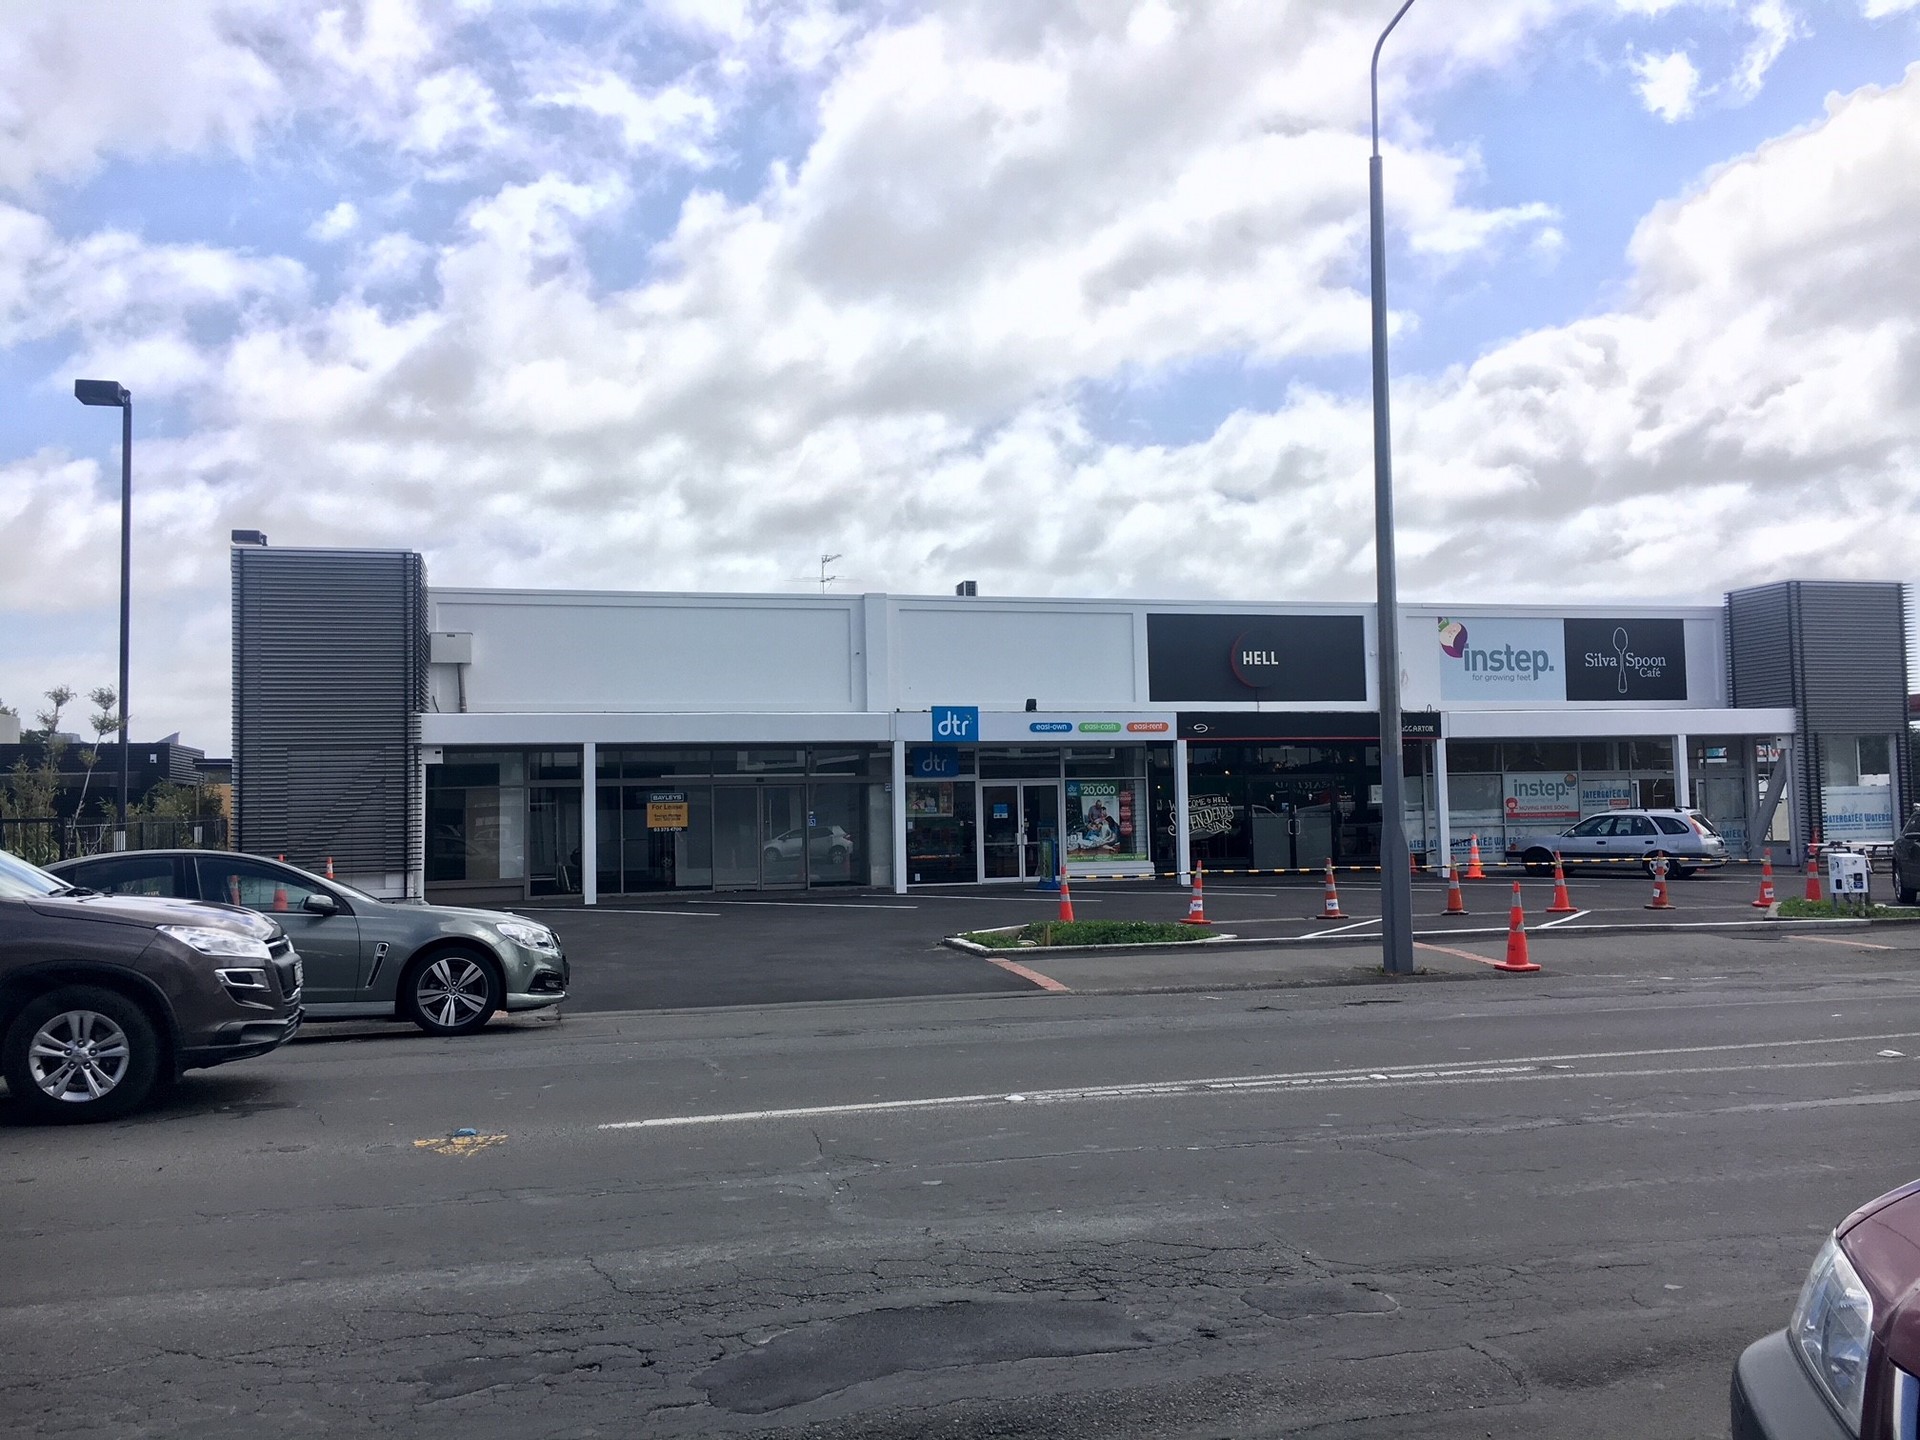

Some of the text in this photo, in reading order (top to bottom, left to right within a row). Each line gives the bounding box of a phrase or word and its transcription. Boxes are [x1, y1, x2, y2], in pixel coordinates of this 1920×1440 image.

[1242, 651, 1278, 664] HELL
[1464, 643, 1554, 680] instep.
[1584, 652, 1666, 669] Silva Spoon
[1485, 674, 1515, 682] growing
[1640, 667, 1661, 677] Café
[938, 711, 969, 736] dtr
[1084, 722, 1116, 730] easi-cash
[922, 752, 947, 771] dtr
[1514, 780, 1569, 801] instep.
